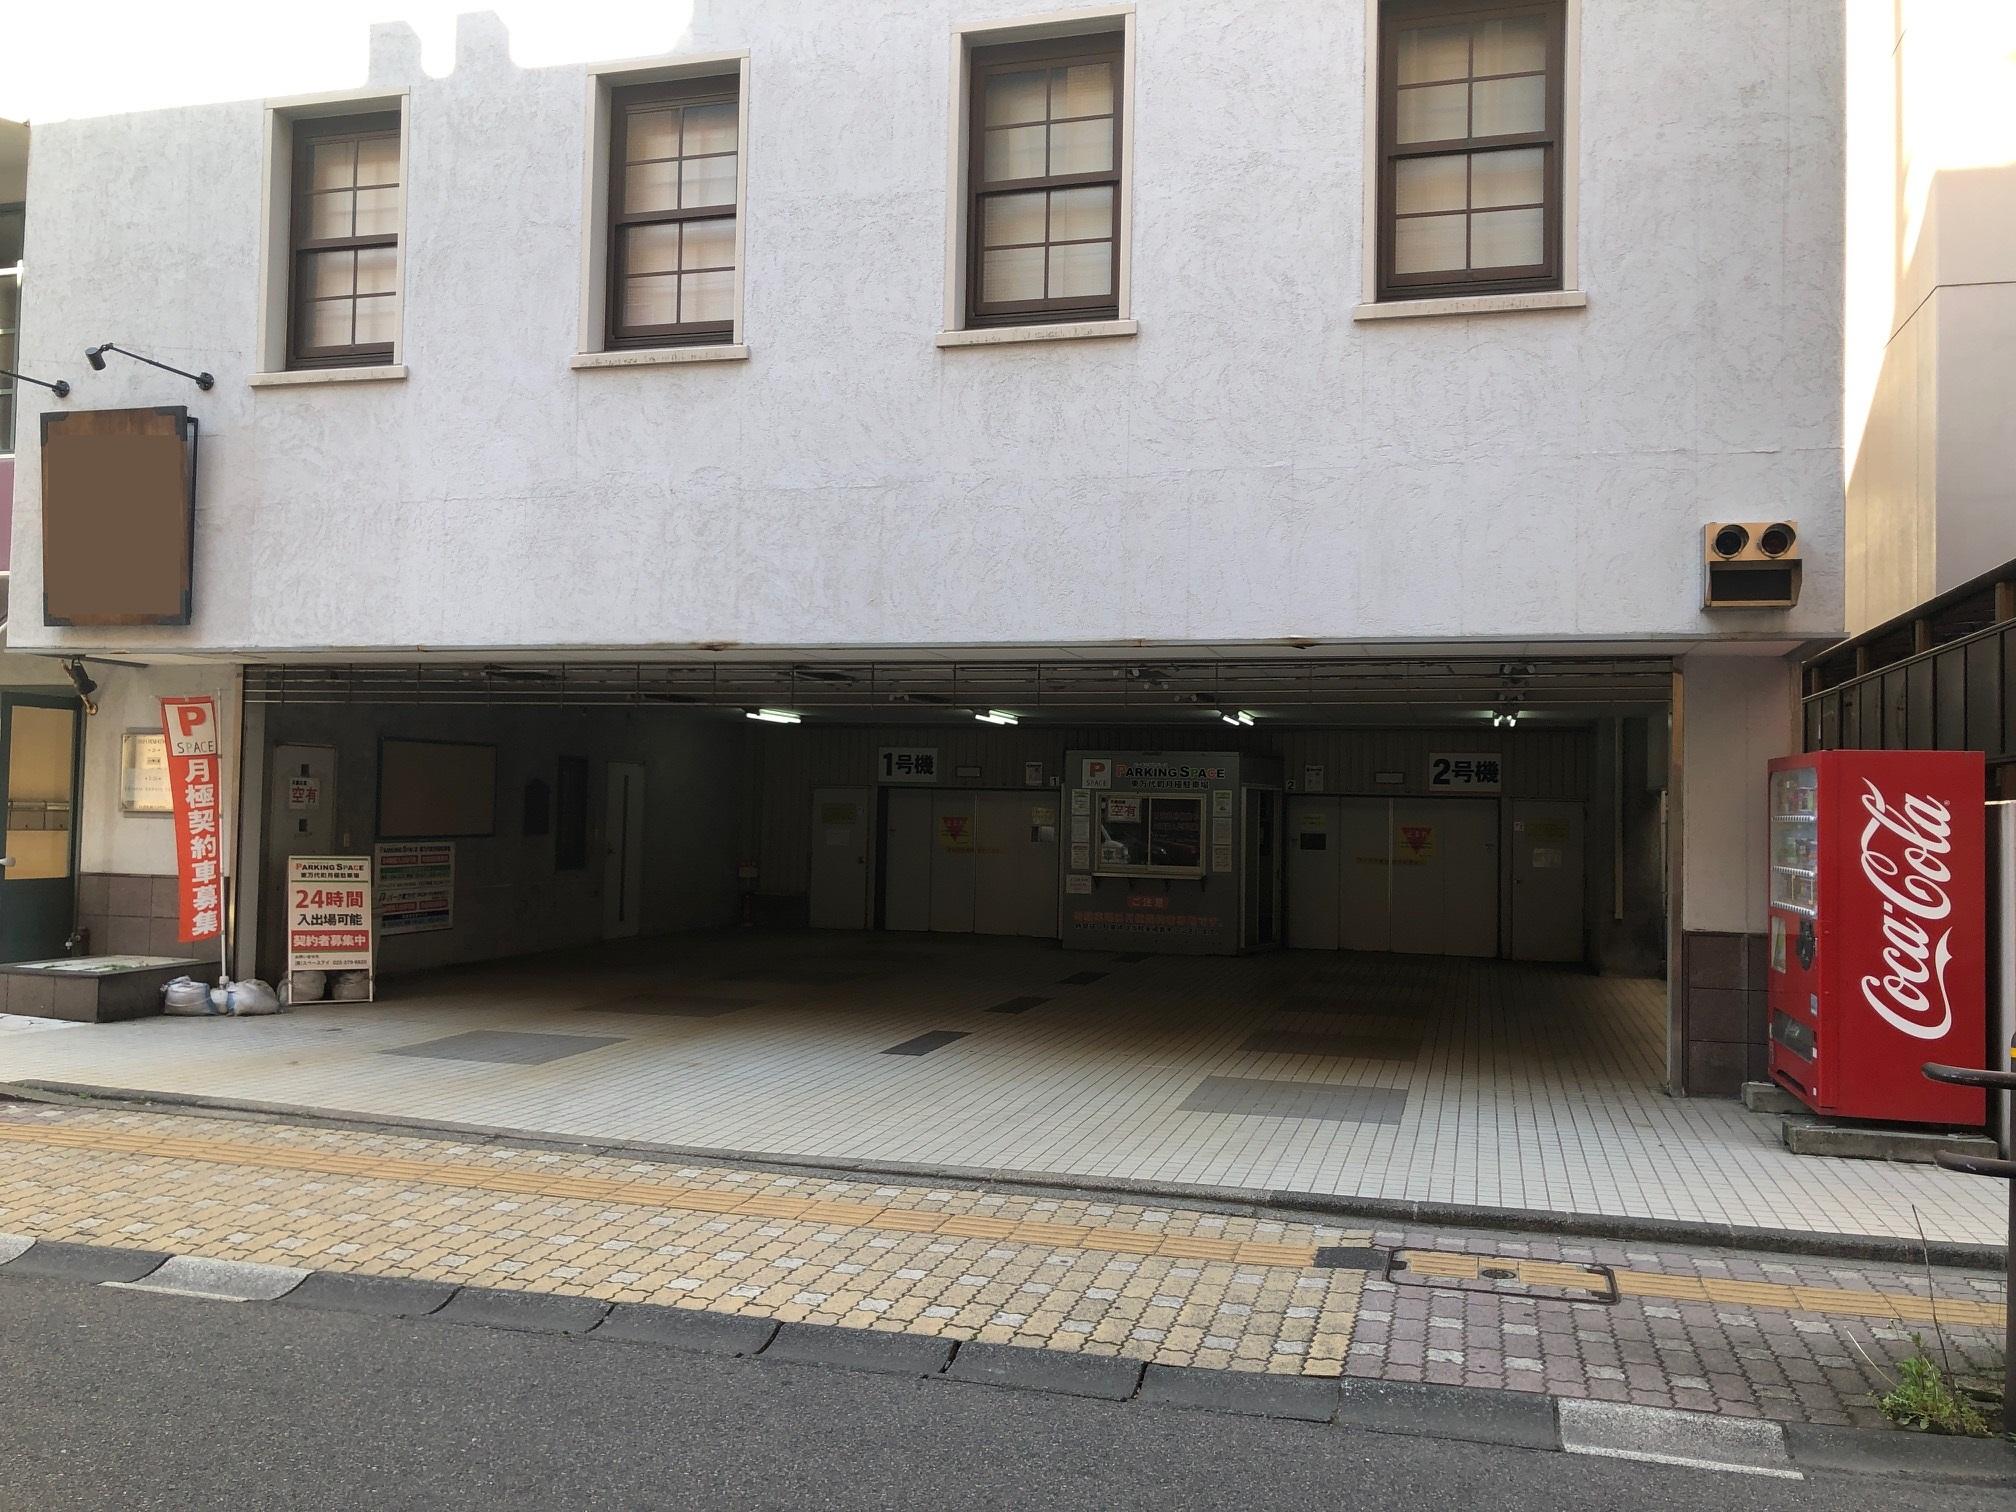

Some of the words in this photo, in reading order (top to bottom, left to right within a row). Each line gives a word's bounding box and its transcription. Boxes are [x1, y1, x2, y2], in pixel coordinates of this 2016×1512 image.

[177, 706, 206, 737] P
[177, 740, 214, 754] SPACE
[883, 752, 934, 776] 1号機
[1089, 761, 1106, 777] P
[1116, 762, 1177, 778] PARKING
[1180, 766, 1225, 780] SPACE
[1433, 758, 1499, 785] 2号機
[1287, 780, 1295, 790] 2
[291, 786, 317, 804] 空有
[1110, 804, 1137, 817] 空有
[185, 758, 218, 936] 月極契約車募集
[296, 863, 335, 871] PARKING
[337, 863, 364, 871] SPACE
[295, 889, 363, 909] 24時間
[1861, 776, 1952, 1040] Coca-Cola
[297, 913, 363, 926] 入出場可能
[293, 934, 366, 947] 契約者募集中
